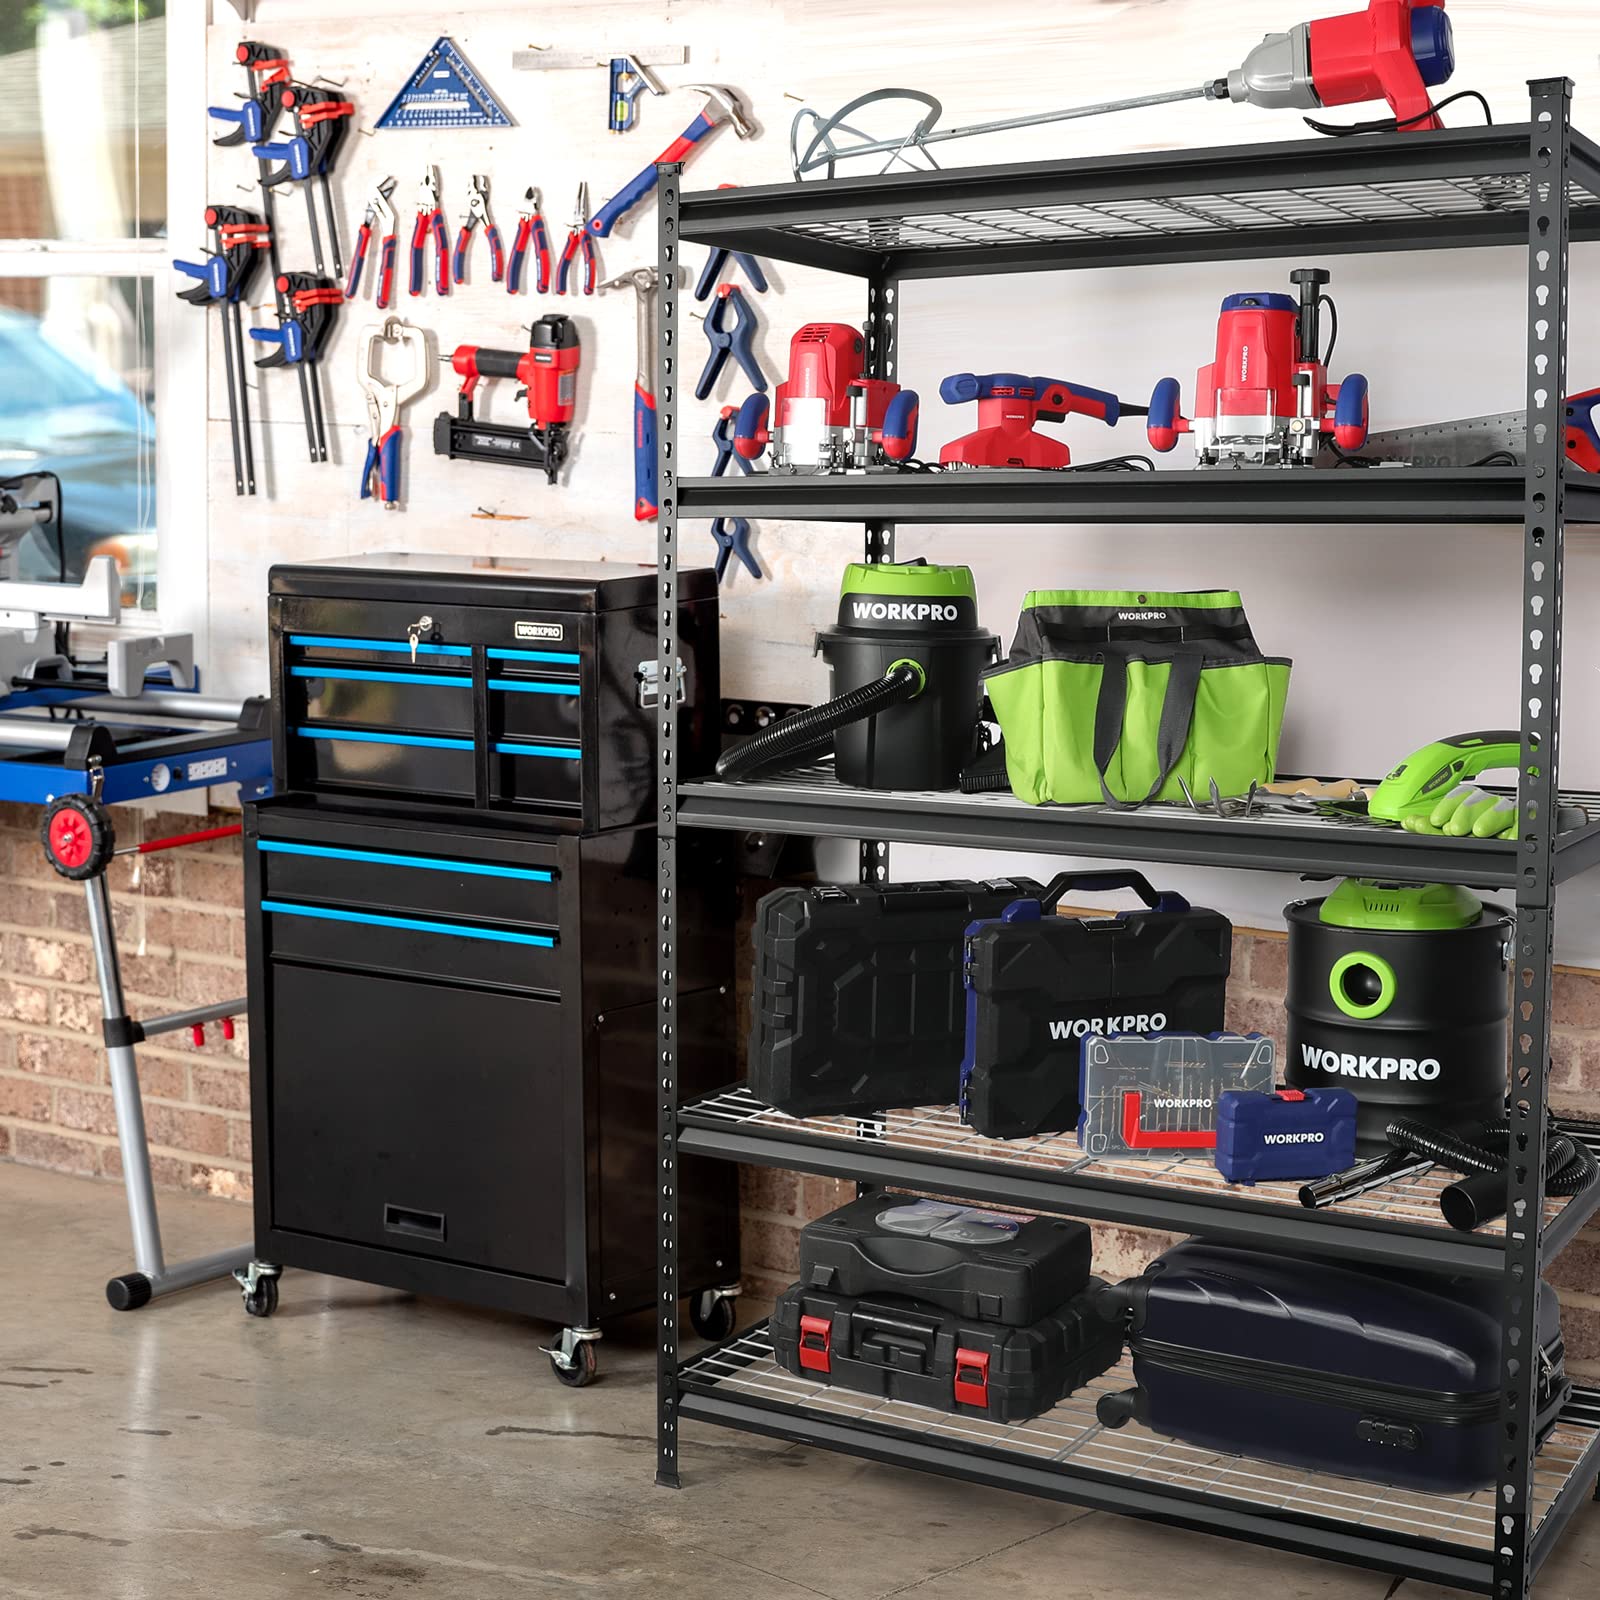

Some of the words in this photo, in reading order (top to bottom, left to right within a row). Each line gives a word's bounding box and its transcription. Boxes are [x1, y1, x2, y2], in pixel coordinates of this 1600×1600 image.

[1241, 345, 1249, 382] WORKPRO
[853, 602, 958, 621] WORKPRO
[1118, 611, 1167, 621] WORKPRO
[518, 625, 560, 637] WORKPRO
[1049, 1012, 1167, 1040] WORKPRO
[1301, 1043, 1441, 1081] WORKPRO
[1153, 1098, 1212, 1108] WORKPRO
[1264, 1132, 1324, 1145] WORKPRO
